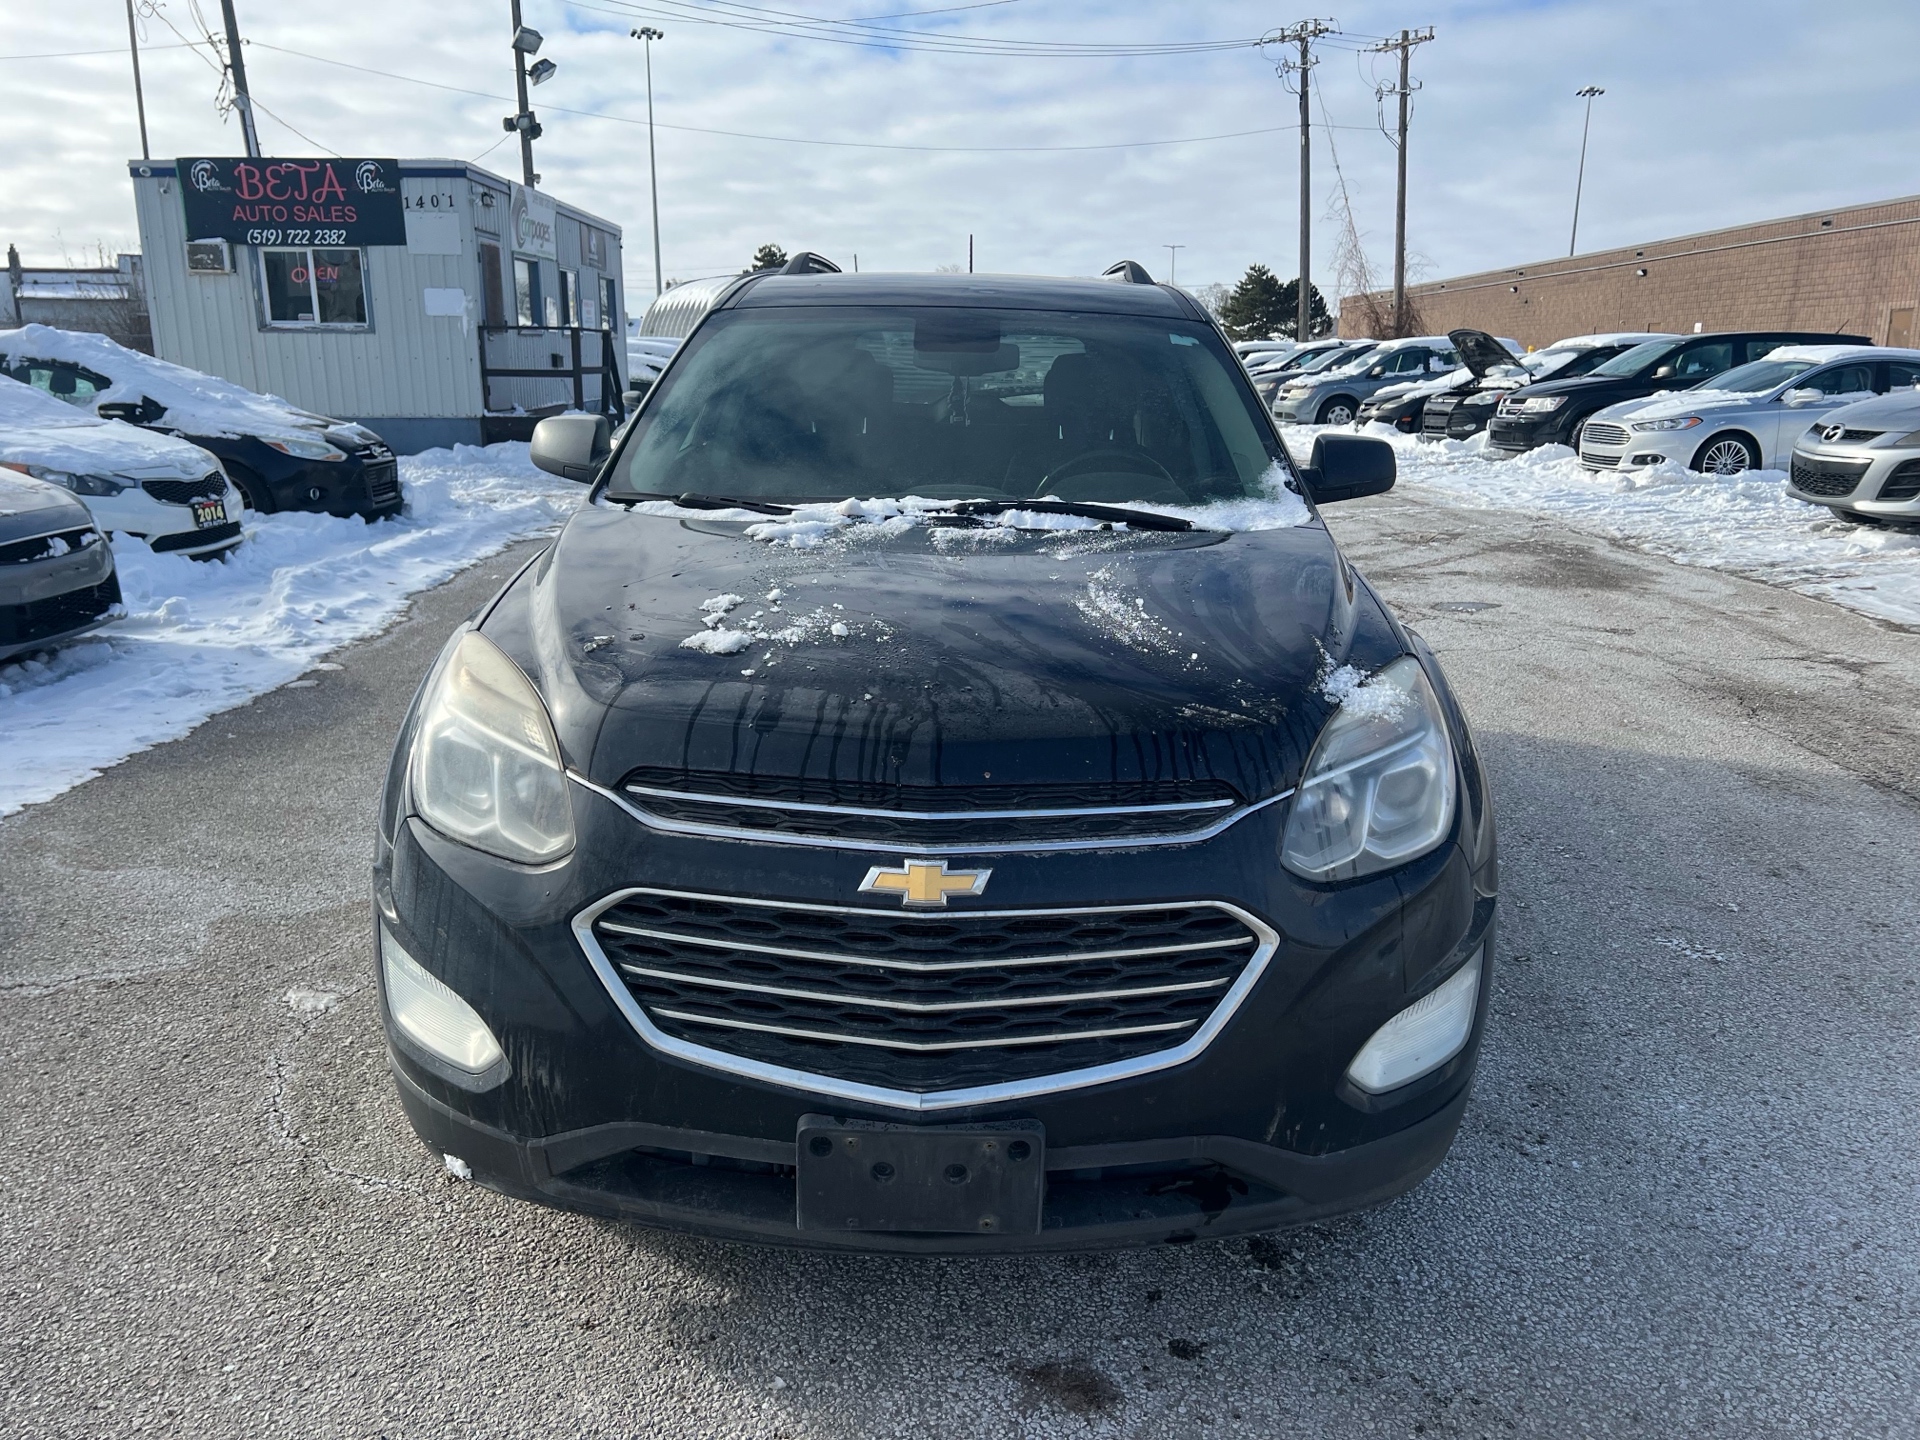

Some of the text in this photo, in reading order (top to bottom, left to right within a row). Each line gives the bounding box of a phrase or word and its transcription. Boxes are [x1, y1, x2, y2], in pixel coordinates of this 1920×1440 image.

[233, 161, 347, 204] BETA
[403, 194, 455, 210] 1401
[232, 204, 357, 222] AUTO SALES
[247, 228, 347, 245] (519) 722 2382
[291, 266, 339, 283] OEN
[198, 506, 224, 522] 2014
